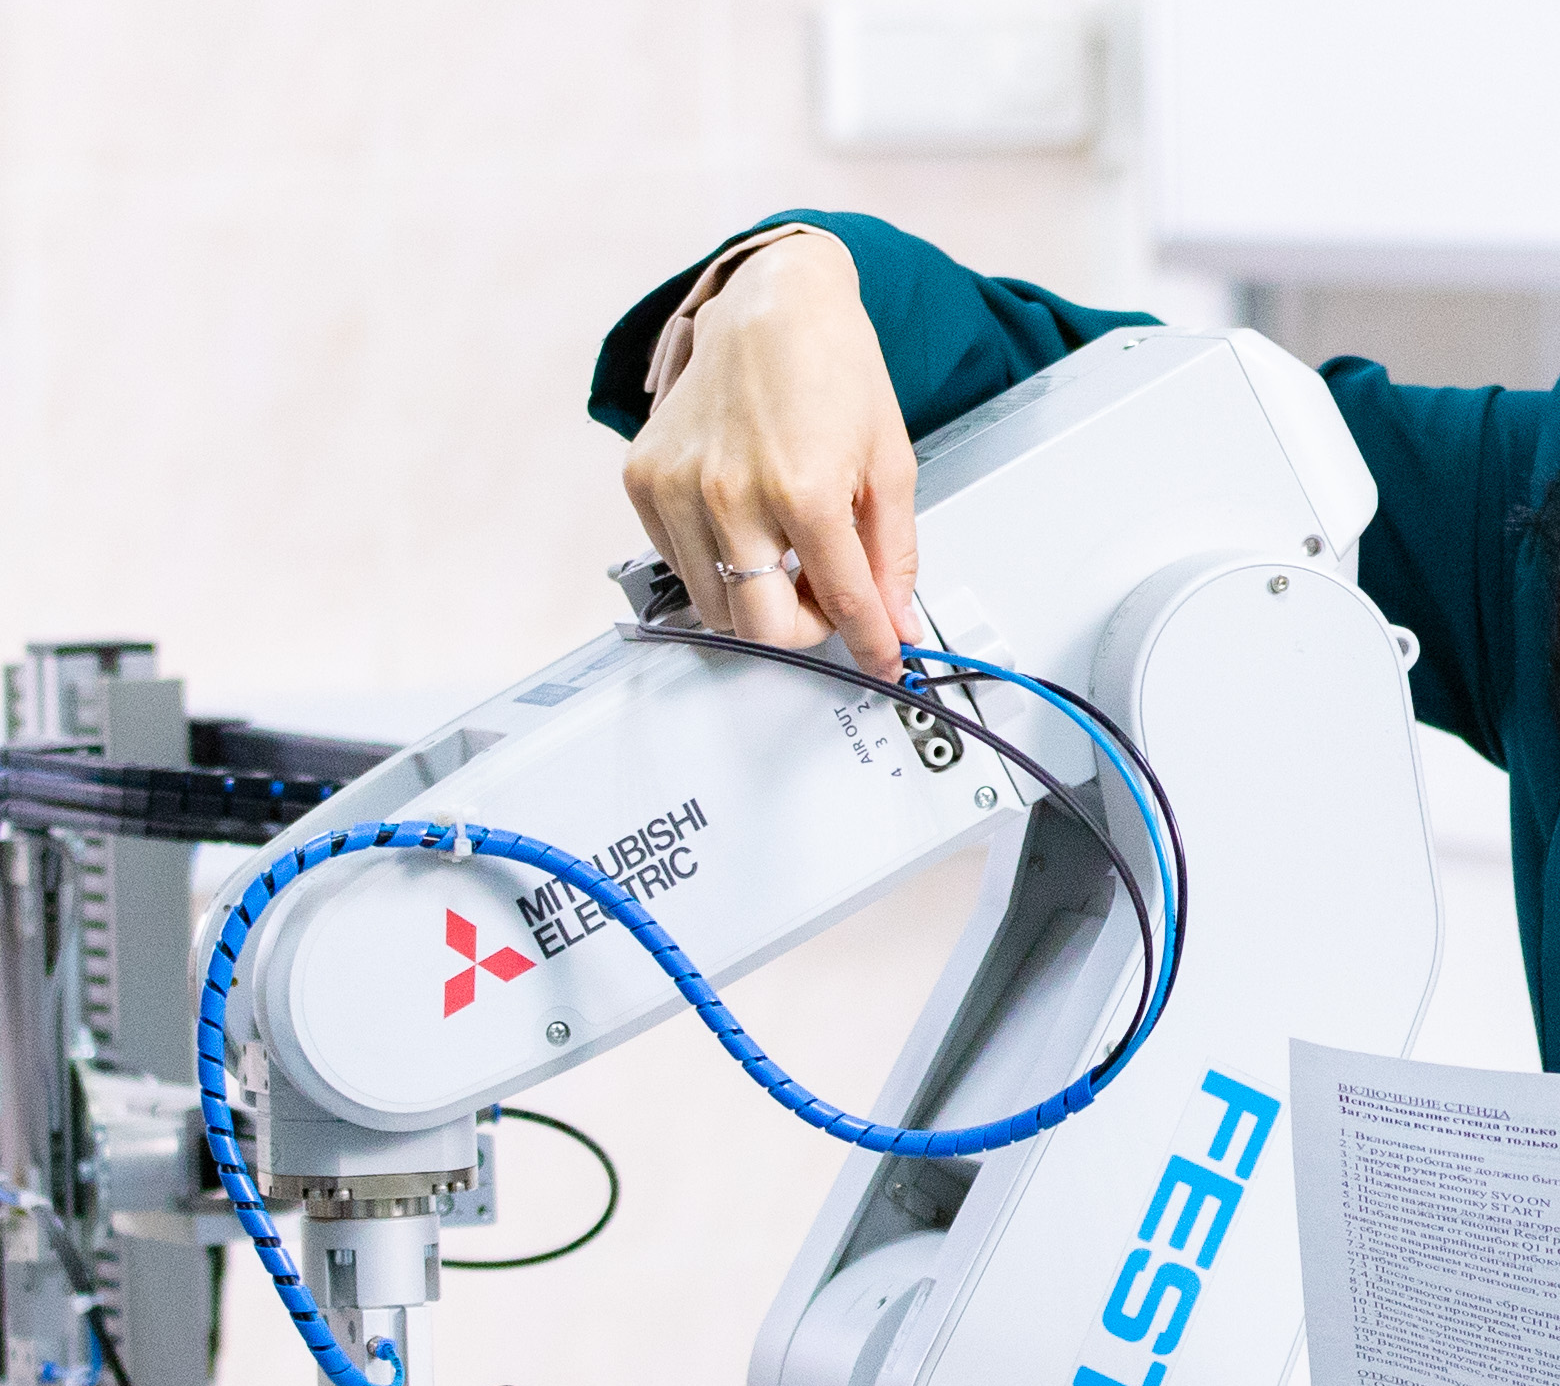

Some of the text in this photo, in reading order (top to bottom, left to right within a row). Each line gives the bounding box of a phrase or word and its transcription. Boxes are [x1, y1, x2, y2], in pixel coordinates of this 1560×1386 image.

[857, 701, 871, 714] 2
[833, 706, 874, 765] AIR OUT
[890, 767, 903, 778] 4
[515, 797, 709, 928] MITUBISHI
[1337, 1082, 1510, 1121] ВКЛЮЧЕНИЕ СТЕНДА
[1338, 1093, 1449, 1122] Использование
[1452, 1116, 1500, 1130] стенда
[1505, 1125, 1556, 1136] только
[1338, 1105, 1410, 1127] Заглушка
[1413, 1122, 1501, 1142] вставляется
[1506, 1137, 1558, 1149] только
[1340, 1127, 1484, 1162] 1. Включаем питание
[1339, 1138, 1351, 1148] 2.
[1356, 1141, 1364, 1150] У
[1369, 1147, 1403, 1160] руки
[1405, 1155, 1453, 1169] робота
[1455, 1163, 1471, 1172] не
[1474, 1168, 1529, 1181] должно
[1340, 1149, 1487, 1186] 3. запуск руки робота
[1341, 1158, 1550, 1206] 3.1 Нажимаем кнопку SVO ON
[1341, 1169, 1541, 1216] 3.2 Нажимаем кнопку START
[1341, 1179, 1353, 1189] 4.
[1357, 1183, 1398, 1200] После
[1400, 1196, 1457, 1213] нажатия
[1460, 1209, 1512, 1225] должна
[1342, 1189, 1354, 1199] 5.
[1357, 1193, 1398, 1211] После
[1401, 1206, 1457, 1223] нажатия
[1460, 1218, 1509, 1234] кнопки
[1513, 1227, 1549, 1242] Reset
[1342, 1200, 1355, 1210] 6.
[1358, 1204, 1444, 1232] Избавляемся
[1447, 1227, 1461, 1235] от
[1464, 1230, 1518, 1247] ошибок
[1521, 1240, 1540, 1251] Q1
[1544, 1246, 1553, 1254] и
[1347, 1237, 1365, 1250] 7.2
[1368, 1245, 1397, 1259] если
[1401, 1255, 1439, 1271] сброс
[1441, 1266, 1457, 1275] не
[1543, 1290, 1557, 1299] то
[1367, 1236, 1461, 1266] поворачиваем
[1463, 1261, 1499, 1275] ключ
